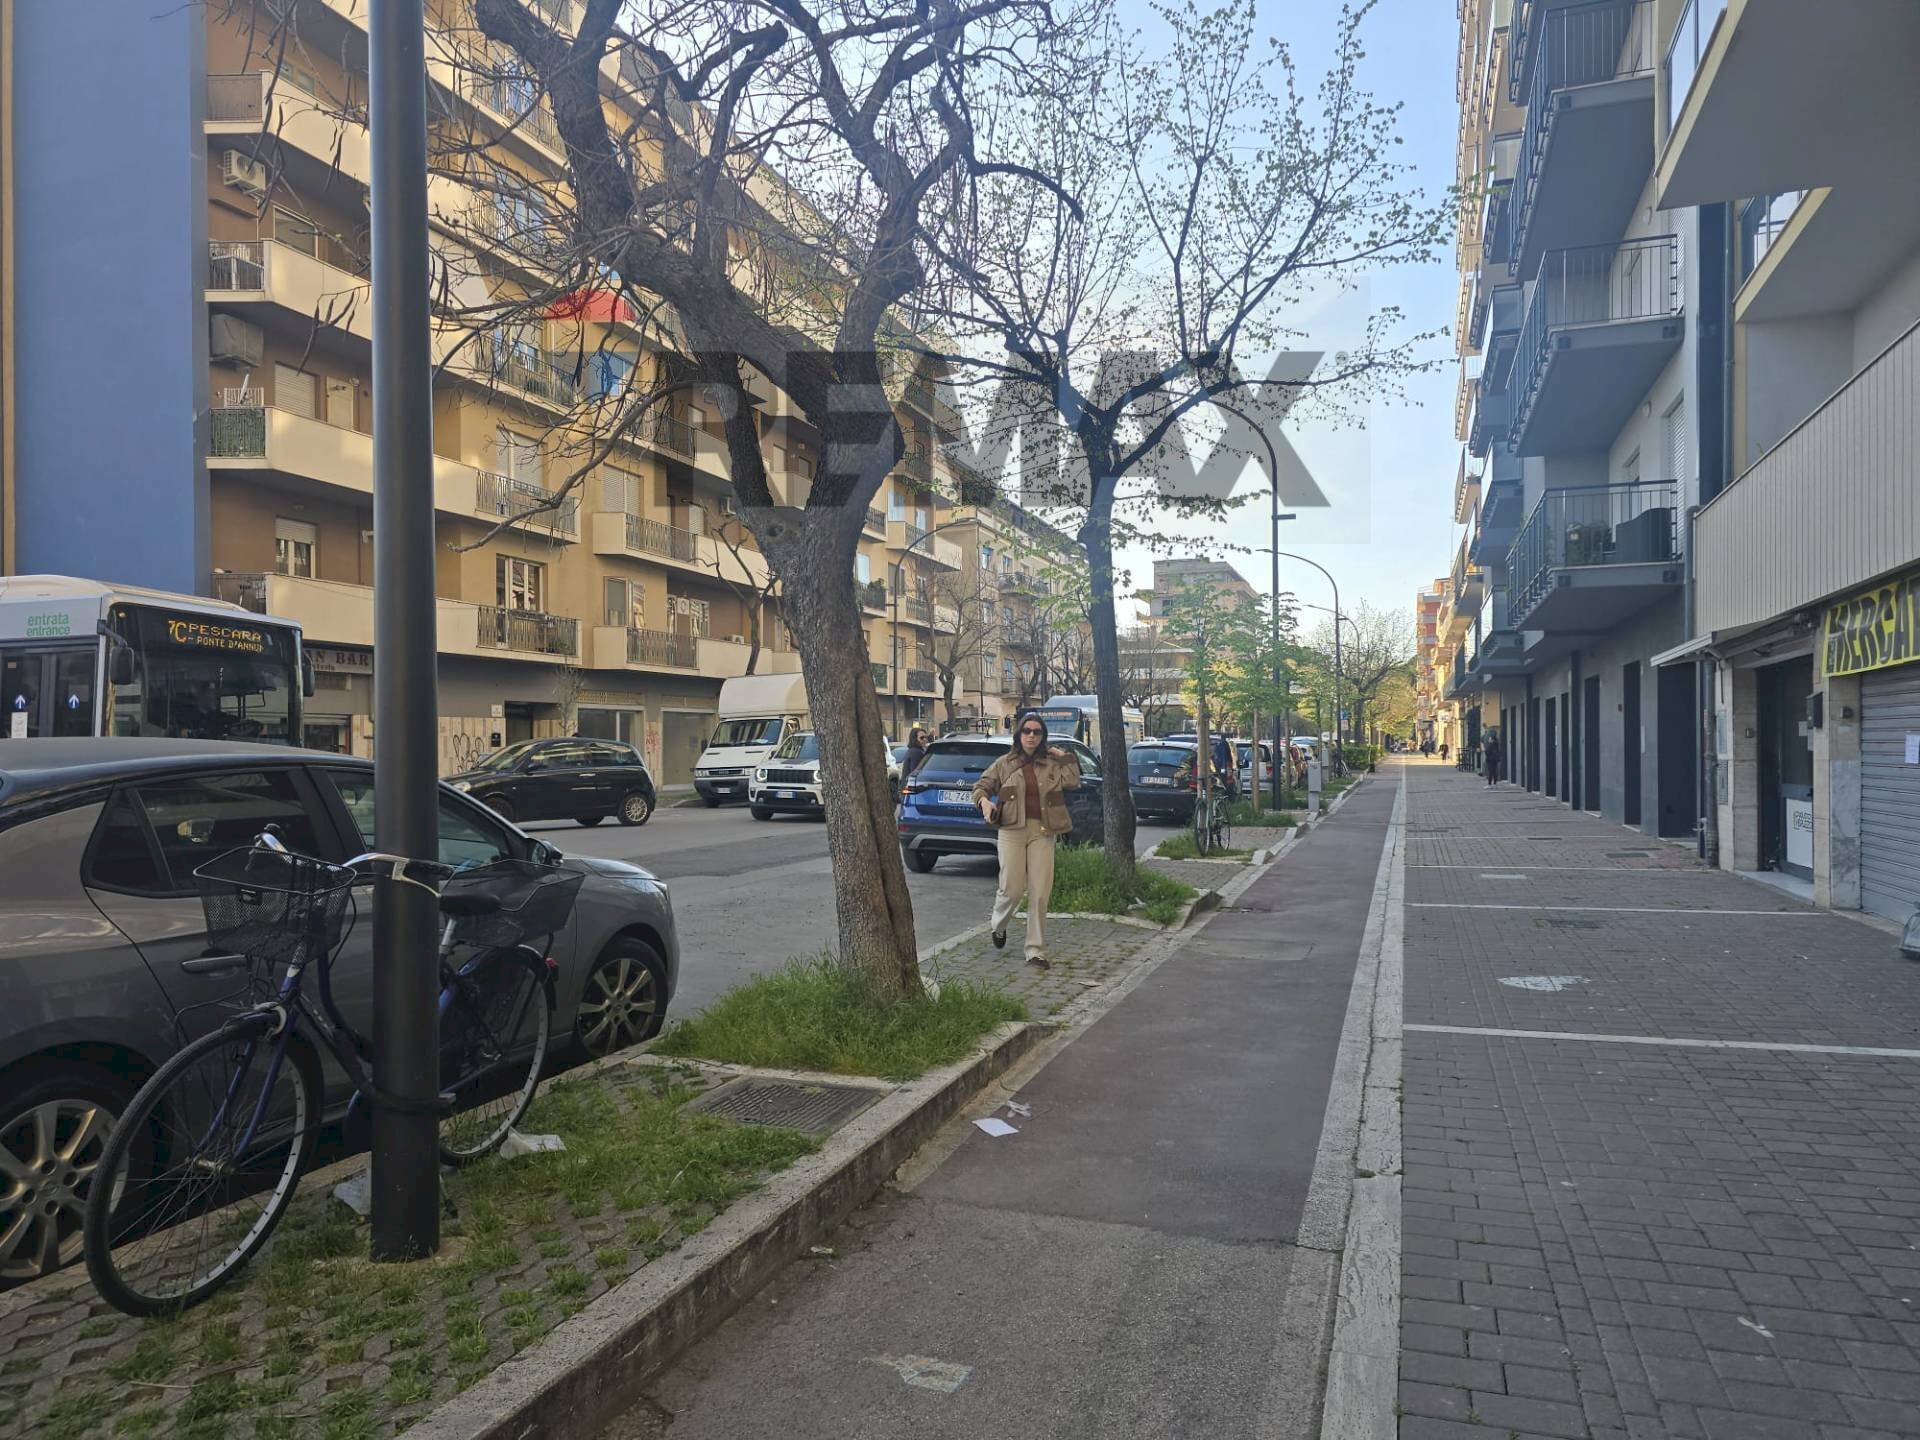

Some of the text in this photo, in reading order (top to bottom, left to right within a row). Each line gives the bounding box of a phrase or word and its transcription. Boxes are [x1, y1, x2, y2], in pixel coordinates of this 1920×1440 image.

[28, 611, 69, 626] entrata
[26, 626, 71, 637] entrance
[168, 620, 261, 643] 7C PESCARA
[197, 635, 225, 648] PONTE
[336, 652, 369, 666] BAR
